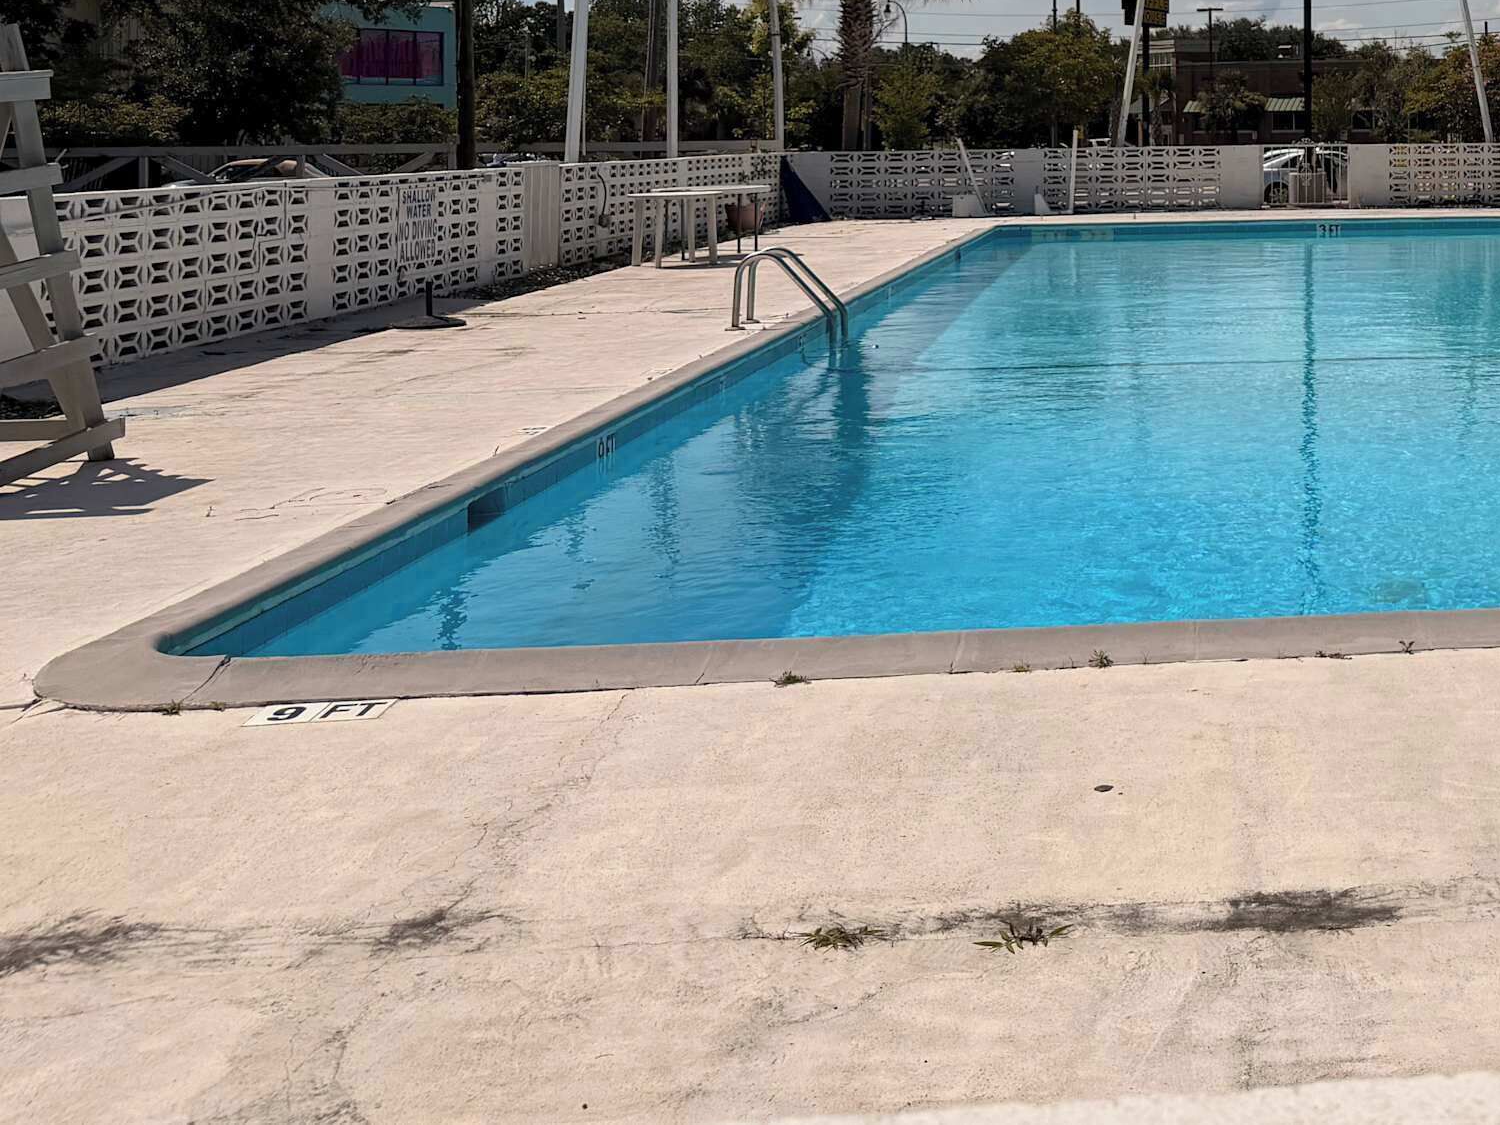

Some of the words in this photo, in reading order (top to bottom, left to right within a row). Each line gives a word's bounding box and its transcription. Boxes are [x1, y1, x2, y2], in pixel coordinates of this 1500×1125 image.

[403, 189, 436, 204] SHALLOW
[407, 203, 432, 219] WATER
[399, 221, 409, 242] NO
[412, 219, 438, 240] DIVING
[400, 239, 436, 263] ALLOWED
[267, 706, 307, 721] 9
[319, 701, 388, 719] FT
